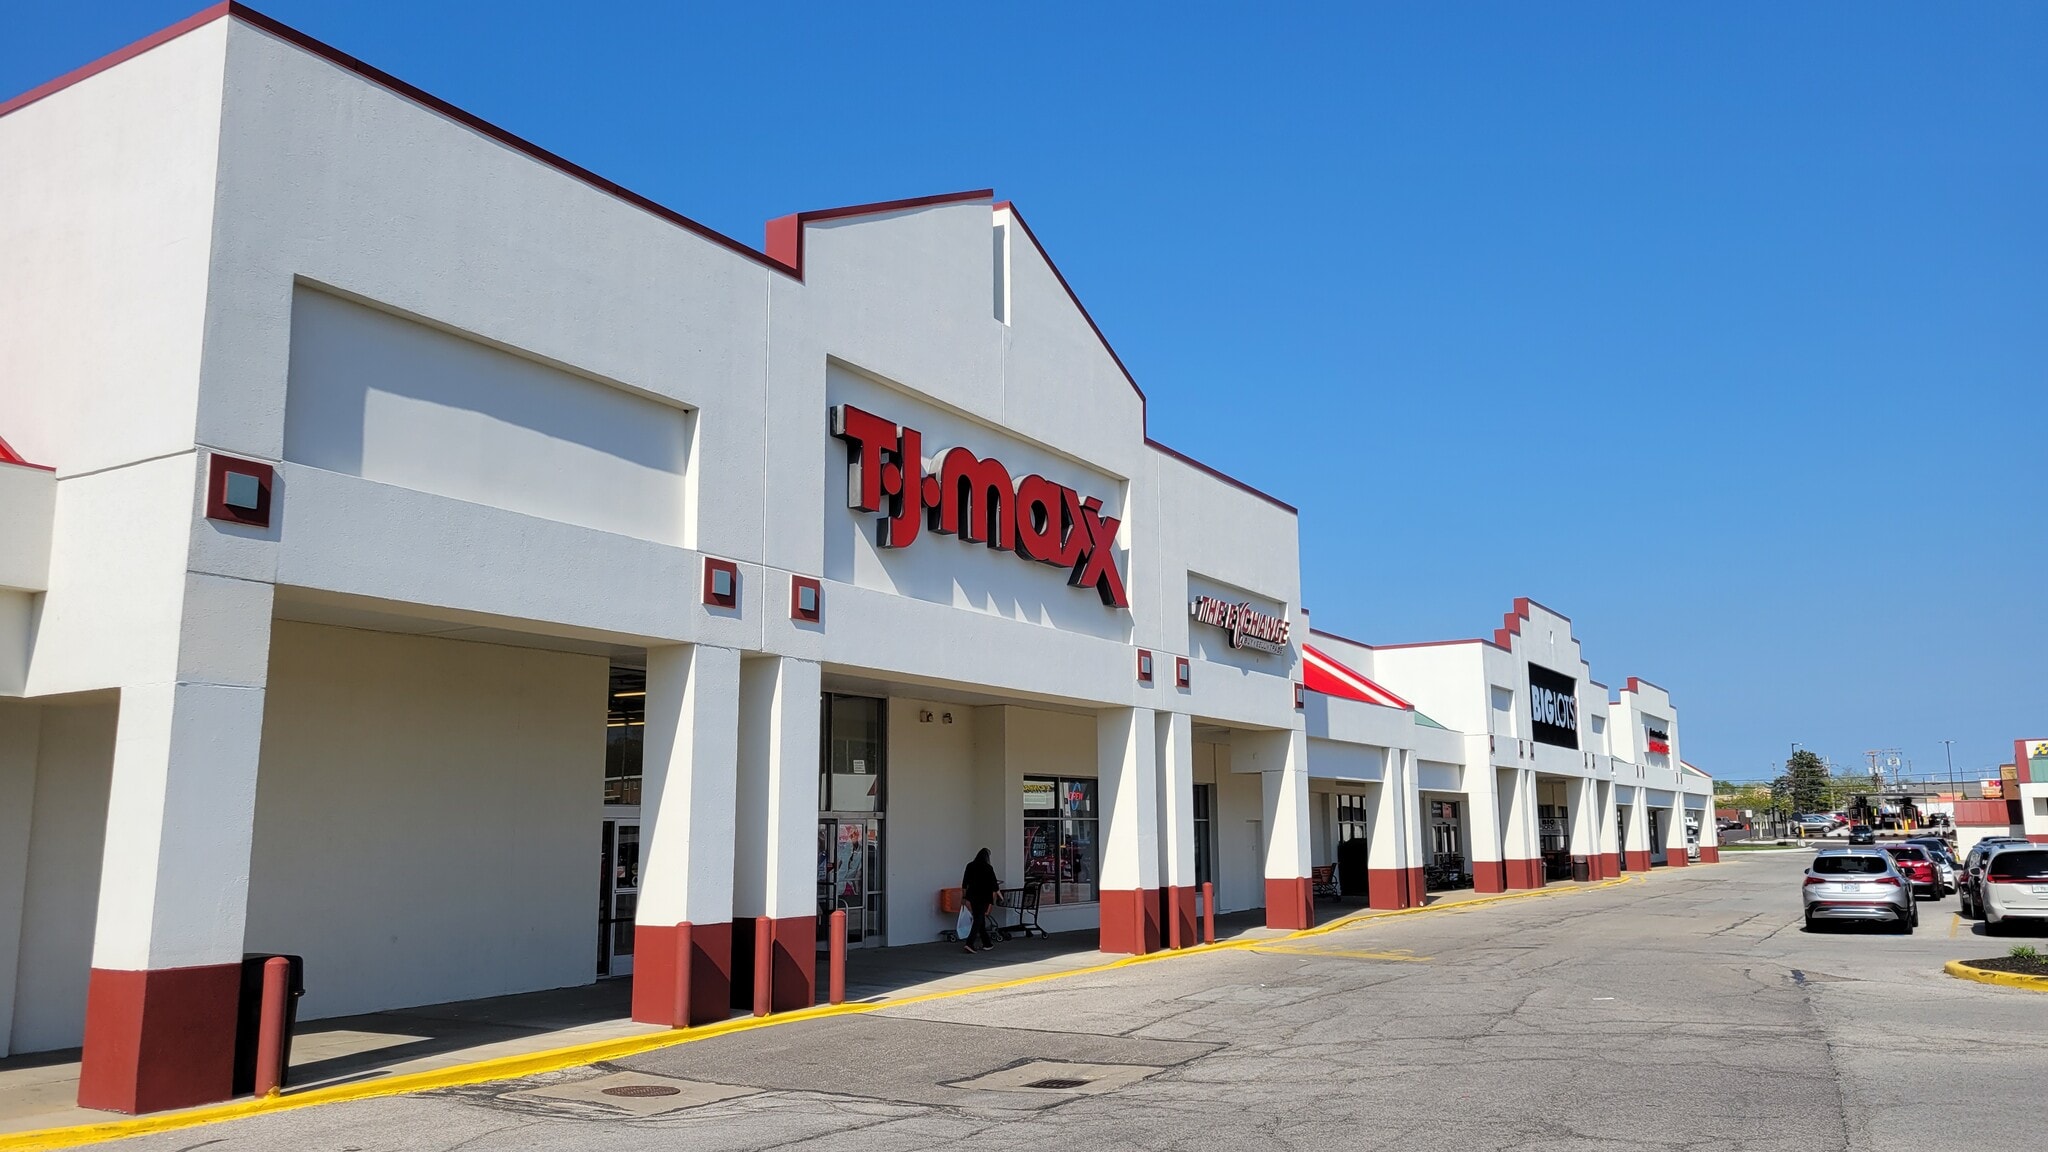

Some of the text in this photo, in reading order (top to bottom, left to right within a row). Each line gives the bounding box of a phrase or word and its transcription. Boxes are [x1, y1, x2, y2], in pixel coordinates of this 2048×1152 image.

[1197, 595, 1290, 649] THE EXCHANGE
[1531, 684, 1576, 730] BIG LOTS
